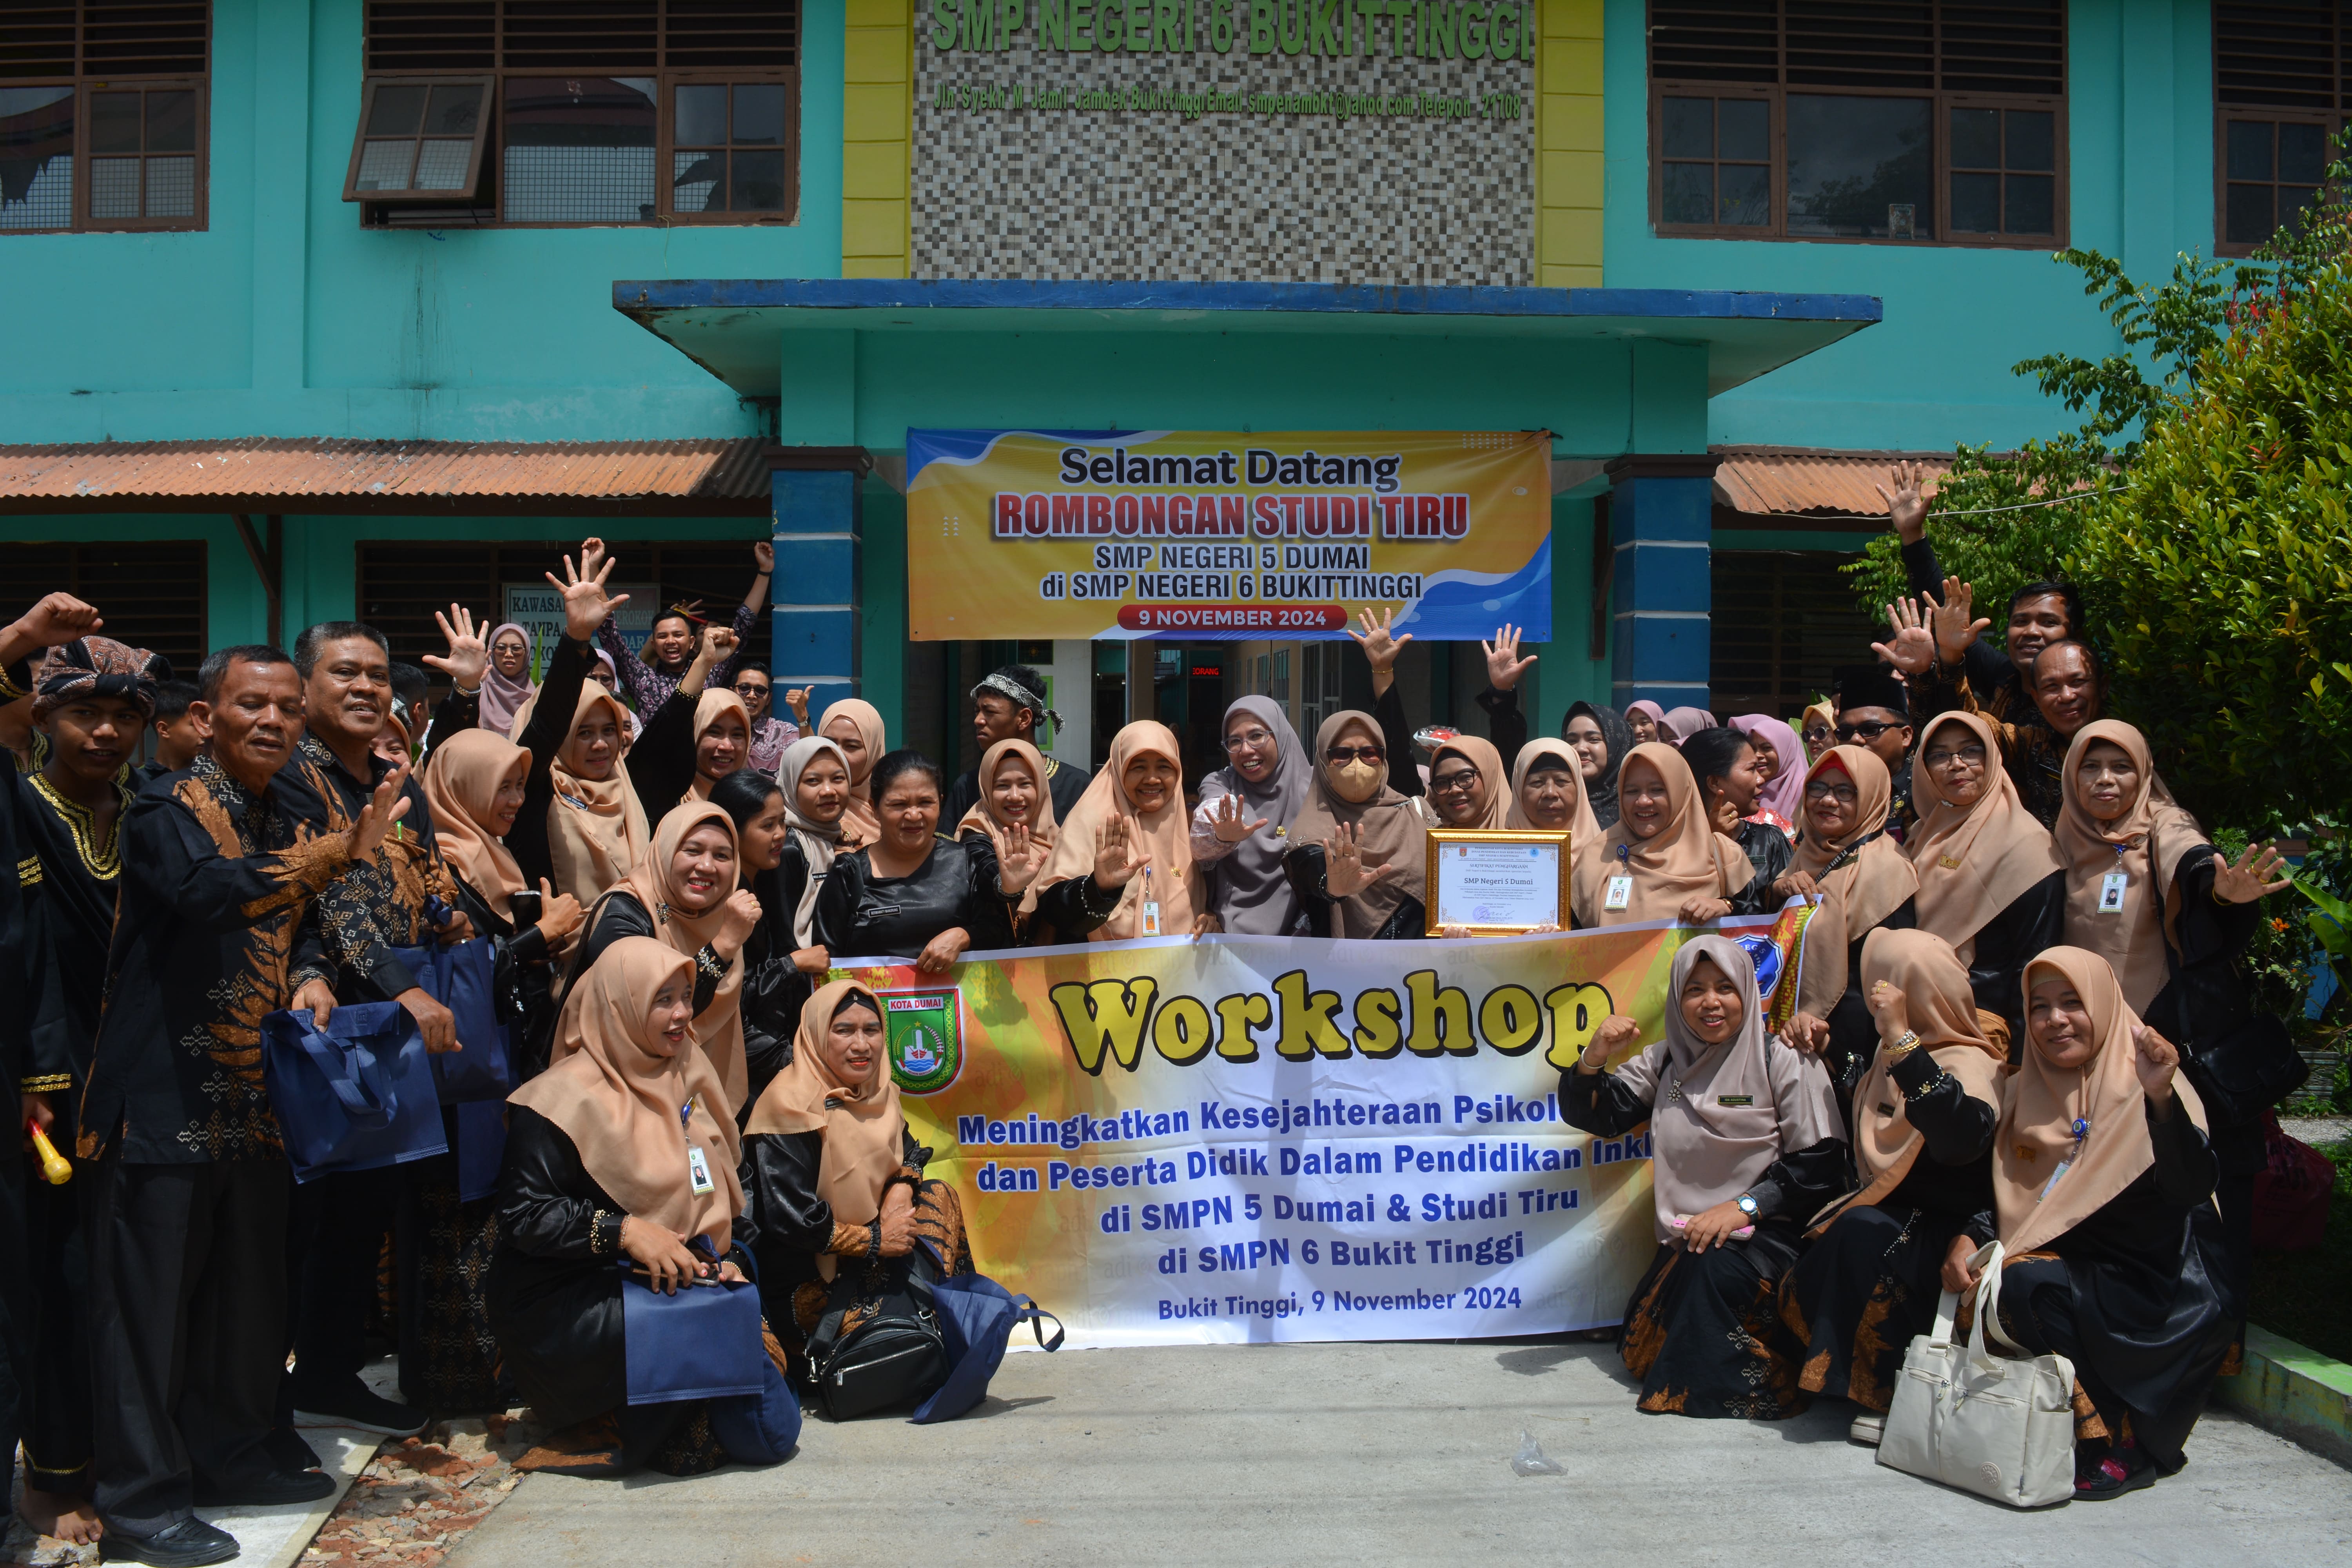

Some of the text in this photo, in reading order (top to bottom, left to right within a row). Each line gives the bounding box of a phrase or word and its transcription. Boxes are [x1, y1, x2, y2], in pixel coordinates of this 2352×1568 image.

[933, 0, 1529, 60] SMP NEGERI 6 BUKITTINGGI
[934, 83, 954, 108] Jln
[962, 83, 1005, 114] Syekh
[1013, 84, 1023, 109] M
[1074, 85, 1127, 110] Jambek
[1131, 85, 1204, 119] Bukittinggi
[1207, 86, 1242, 111] Email
[1419, 91, 1470, 122] Telepon
[1482, 93, 1520, 118] 21708
[1062, 448, 1399, 492] Selamat Datang
[999, 495, 1467, 536] ROMBONGAN STUDI TIRU
[1097, 546, 1367, 569] SMP NEGERI 5 DUMAI
[513, 597, 565, 612] KAWASA
[1043, 575, 1421, 598] di SMP NEGERI 6 BUKITTINGGI
[1139, 610, 1326, 625] 9 NOVEMBER 2024
[891, 998, 941, 1010] KOTA DUMAI
[1049, 969, 1615, 1076] Workshop
[962, 1095, 1566, 1149] Meningkatkan Kesejahteraan Psikol
[978, 1162, 1037, 1191] dan
[1049, 1158, 1176, 1189] Peserta
[1187, 1149, 1269, 1180] Didik
[1280, 1147, 1381, 1175] Dalam
[1395, 1142, 1581, 1172] Pendidikan
[1102, 1189, 1578, 1233] di SMPN 5 Dumai & Studi Tiru
[1158, 1231, 1524, 1274] di SMPN 6 Bukit Tinggi
[1159, 1287, 1521, 1319] Bukit Tinggi, 9 November 2024
